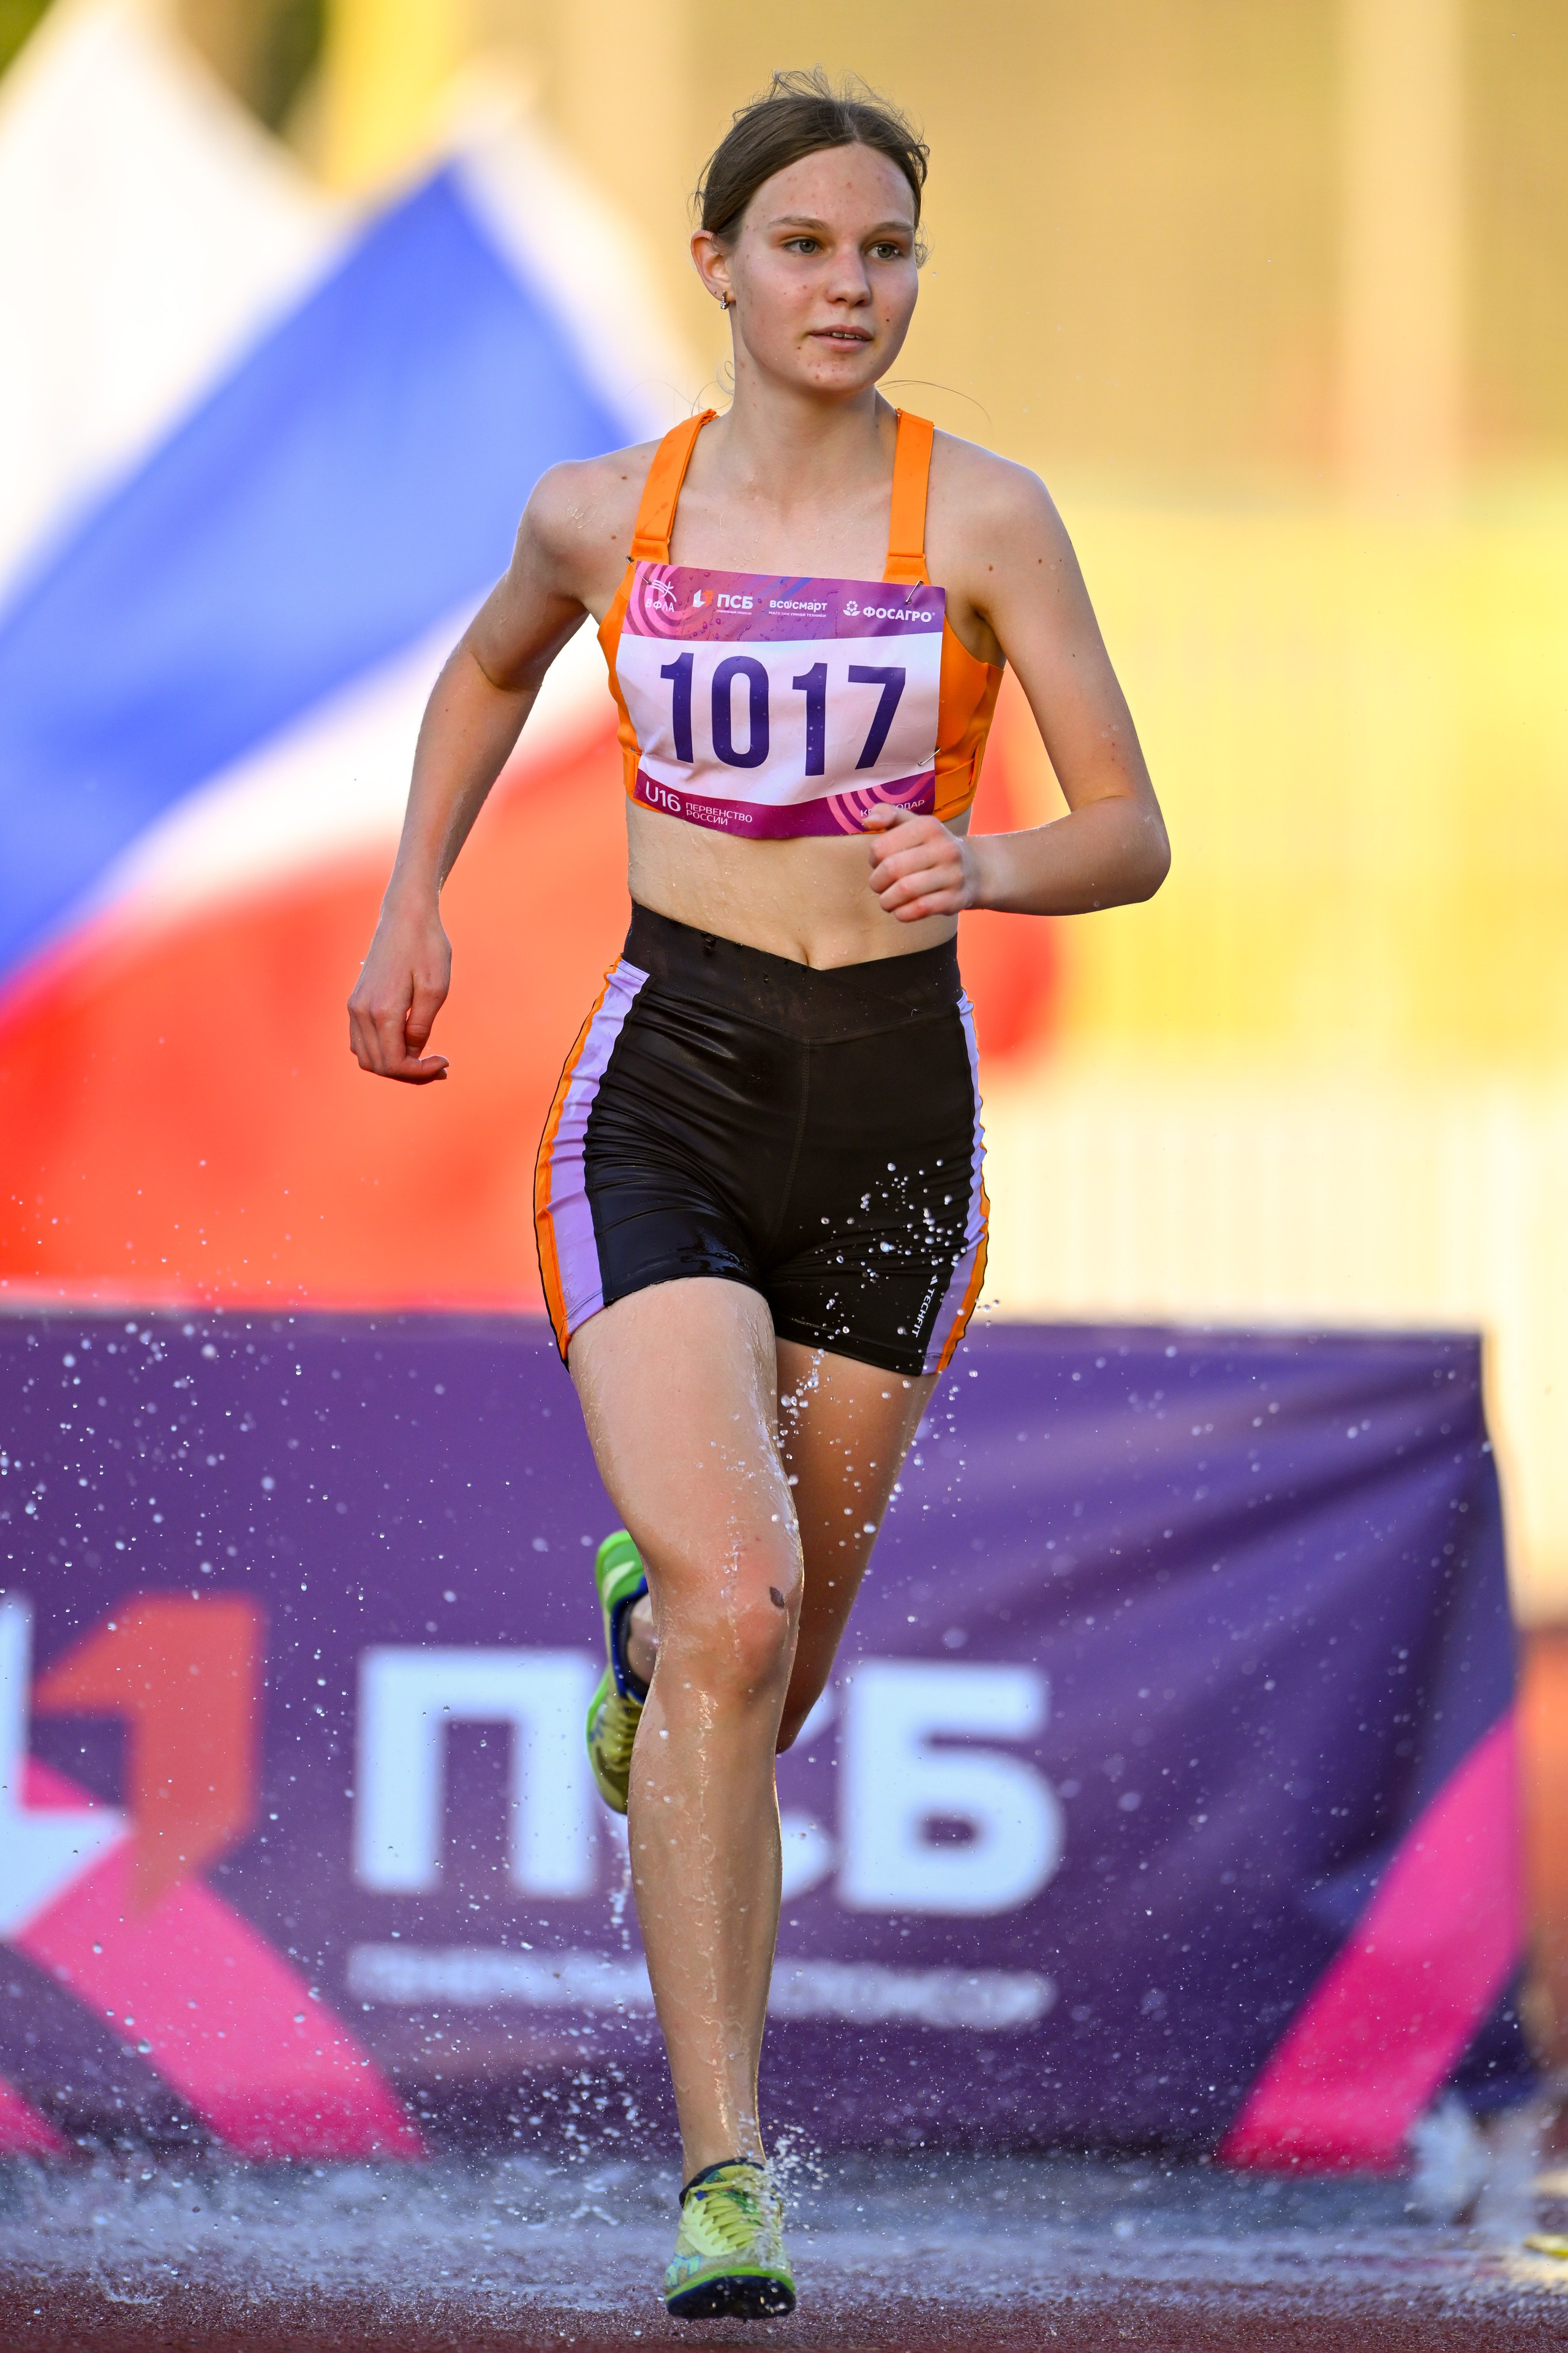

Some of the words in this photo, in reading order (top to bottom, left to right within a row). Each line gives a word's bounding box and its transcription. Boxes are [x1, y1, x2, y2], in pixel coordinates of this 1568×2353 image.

[645, 599, 674, 613] ВФЛА
[717, 594, 753, 610] ПСБ
[862, 606, 932, 622] ФОСАГРО
[660, 652, 906, 776] 1017
[645, 780, 681, 812] U16
[685, 802, 753, 823] ПЕРВЕНСТВО
[686, 809, 728, 826] РОССИИ
[861, 799, 925, 817] КОДАР
[911, 1288, 935, 1338] TECHFIT
[354, 1647, 1065, 1916] ПБ
